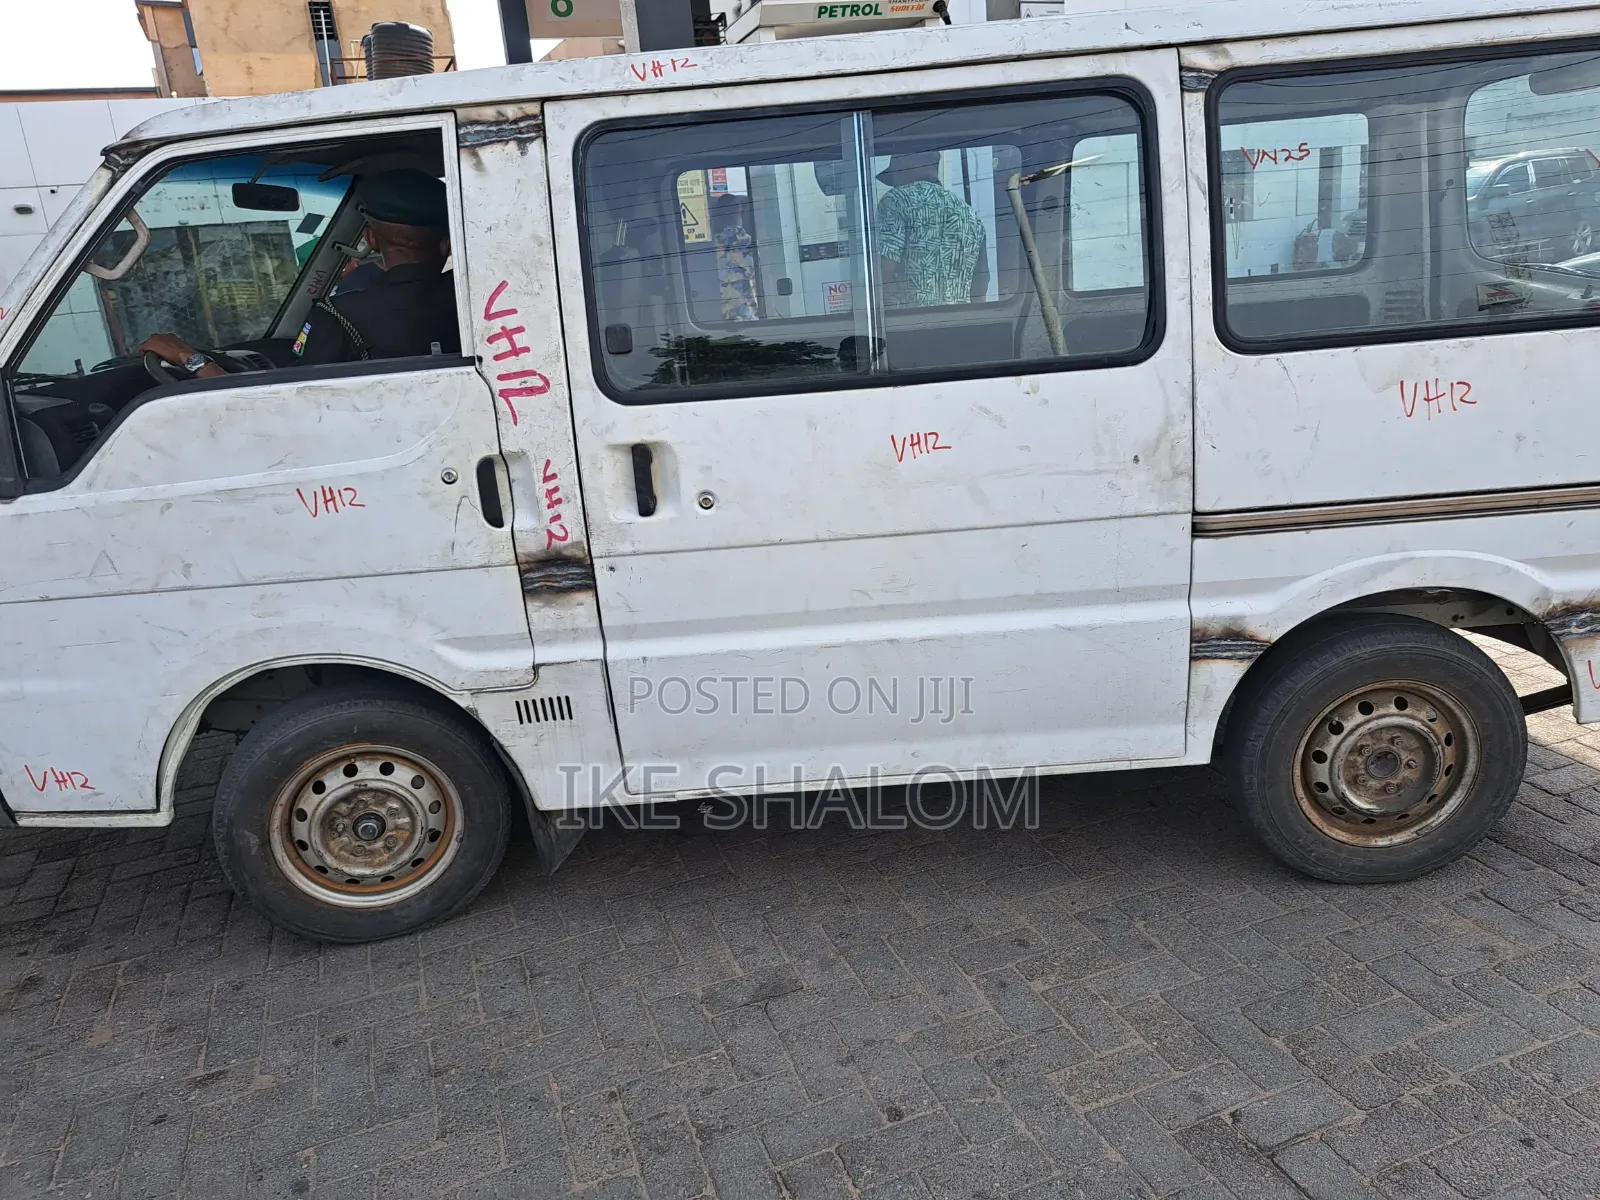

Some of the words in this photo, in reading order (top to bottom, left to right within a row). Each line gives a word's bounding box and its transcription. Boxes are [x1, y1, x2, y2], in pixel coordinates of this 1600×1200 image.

[817, 3, 883, 18] PETROL
[630, 60, 696, 82] VH12
[1240, 143, 1311, 170] VN25
[1400, 378, 1477, 420] VH12
[891, 432, 951, 462] VH12
[296, 485, 366, 518] VH12
[542, 459, 568, 550] VH12
[24, 764, 96, 792] VH12
